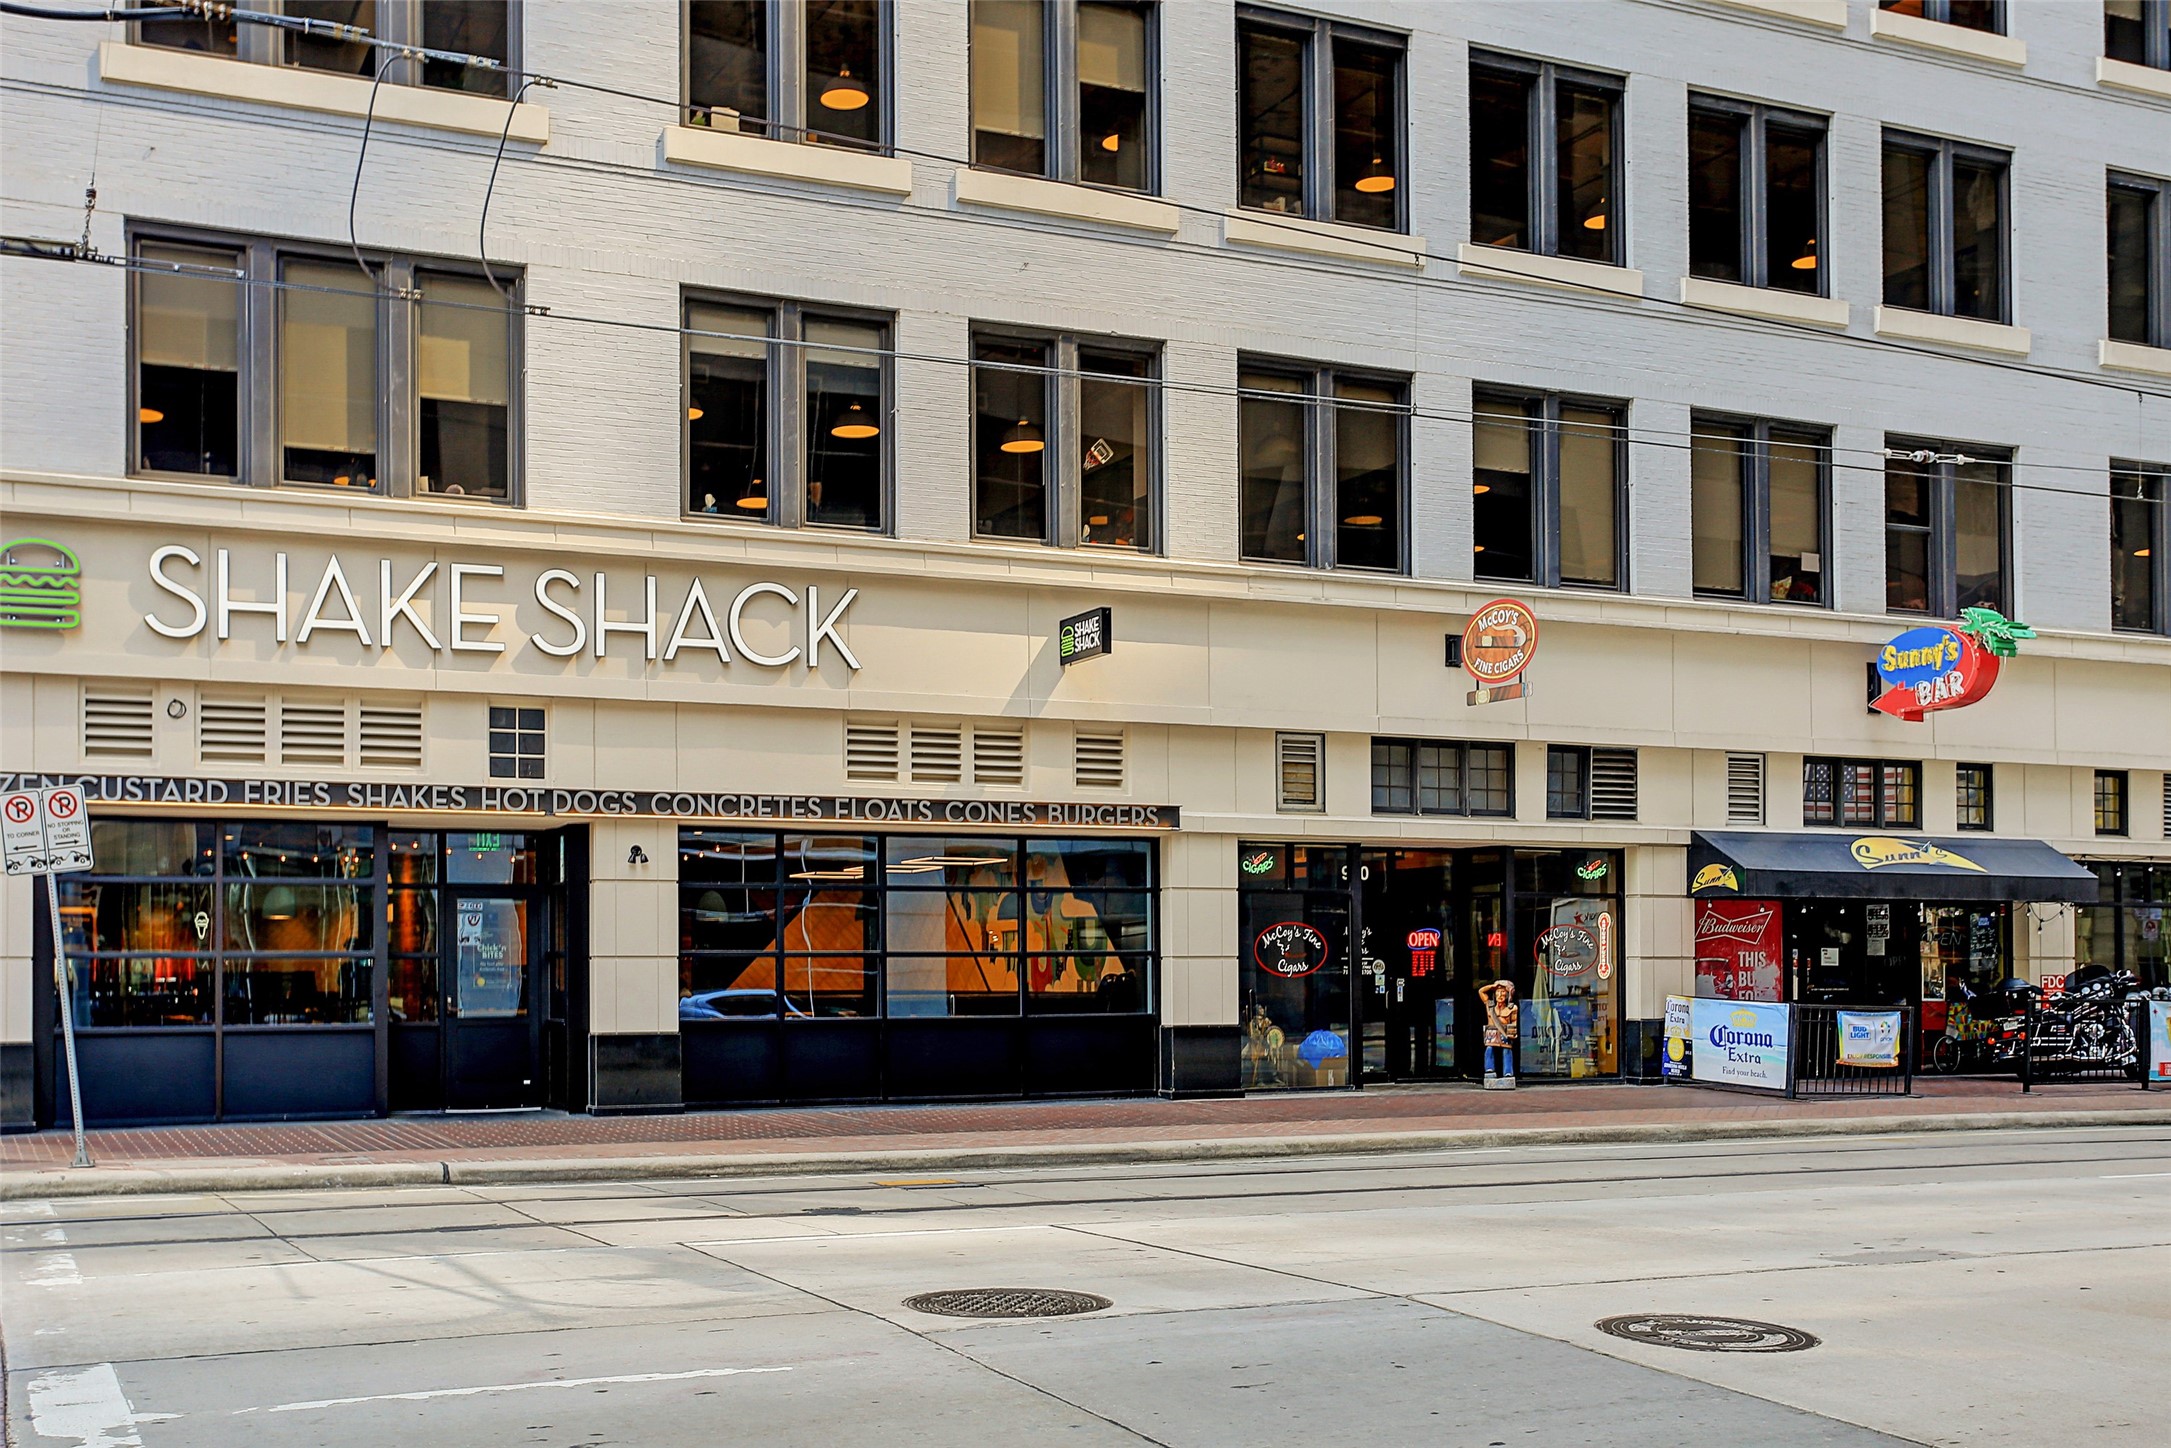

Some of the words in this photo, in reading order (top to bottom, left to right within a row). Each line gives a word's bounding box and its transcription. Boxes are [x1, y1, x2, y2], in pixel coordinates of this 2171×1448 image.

[143, 544, 506, 652] SHAKE
[530, 568, 863, 671] SHACK
[1074, 616, 1100, 638] SHAKE
[1478, 609, 1519, 632] McCOY'S
[1074, 631, 1101, 653] SHACK
[1473, 657, 1493, 674] FINE
[1494, 649, 1524, 674] CIGARS
[1883, 634, 1959, 672] Sunny's
[1914, 670, 1965, 707] BAR
[75, 775, 228, 804] CUSTARD
[244, 780, 329, 808] FRIES
[347, 783, 467, 811] SHAKES
[480, 787, 545, 812] HOT
[551, 789, 636, 816] DOGS
[650, 792, 822, 820] CONCRETES
[834, 797, 933, 823] FLOATS
[944, 801, 1037, 825] CONES
[1047, 803, 1160, 827] BURGERS
[16, 830, 40, 838] CORNER
[53, 832, 81, 840] STANDING
[1242, 855, 1274, 874] CIGARS
[1577, 863, 1607, 880] CIGARS
[1698, 917, 1764, 934] Budweiser
[1261, 924, 1302, 949] McCoy's
[1302, 928, 1322, 949] Fine
[1408, 932, 1438, 947] OPEN
[1540, 927, 1576, 950] McCoy's
[1577, 929, 1594, 950] Fine
[482, 952, 504, 960] BITES
[1738, 951, 1767, 968] THIS
[1277, 958, 1310, 978] Cigars
[1554, 958, 1583, 977] Cigars
[2041, 975, 2065, 989] FDC
[1665, 1000, 1690, 1015] Corona
[1670, 1013, 1686, 1024] Extra
[1709, 1024, 1774, 1050] Corona
[1728, 1046, 1762, 1064] Extra
[1722, 1066, 1735, 1075] Find
[1736, 1068, 1749, 1078] your
[1750, 1067, 1768, 1079] beach.
